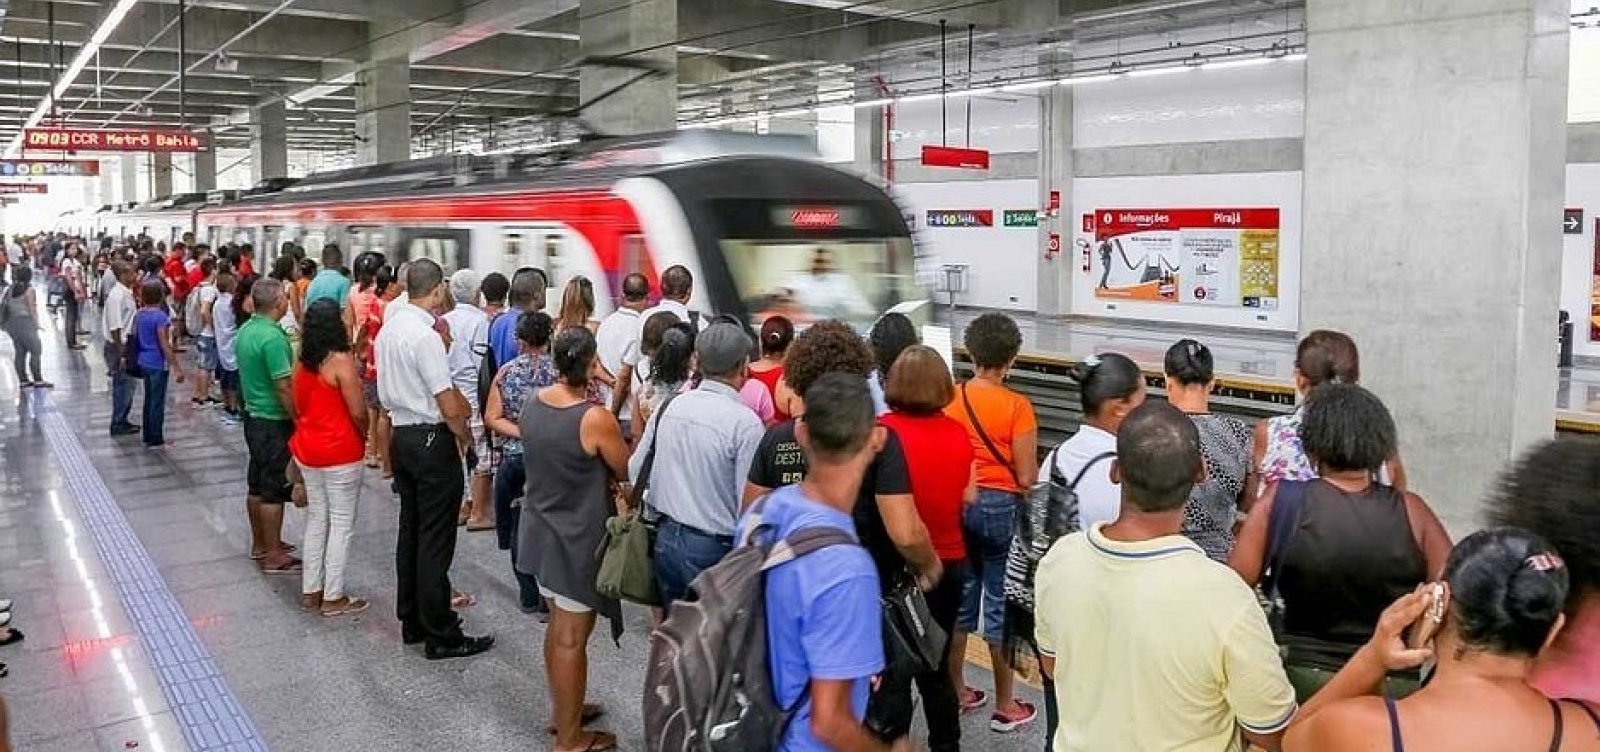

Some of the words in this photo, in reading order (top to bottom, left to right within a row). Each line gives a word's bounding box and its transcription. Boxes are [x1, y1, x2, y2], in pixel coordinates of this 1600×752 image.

[71, 132, 99, 145] CCR
[106, 133, 150, 146] Metrô
[156, 134, 199, 147] Bahia
[1118, 211, 1170, 227] Informações
[1213, 211, 1241, 226] Pirajá
